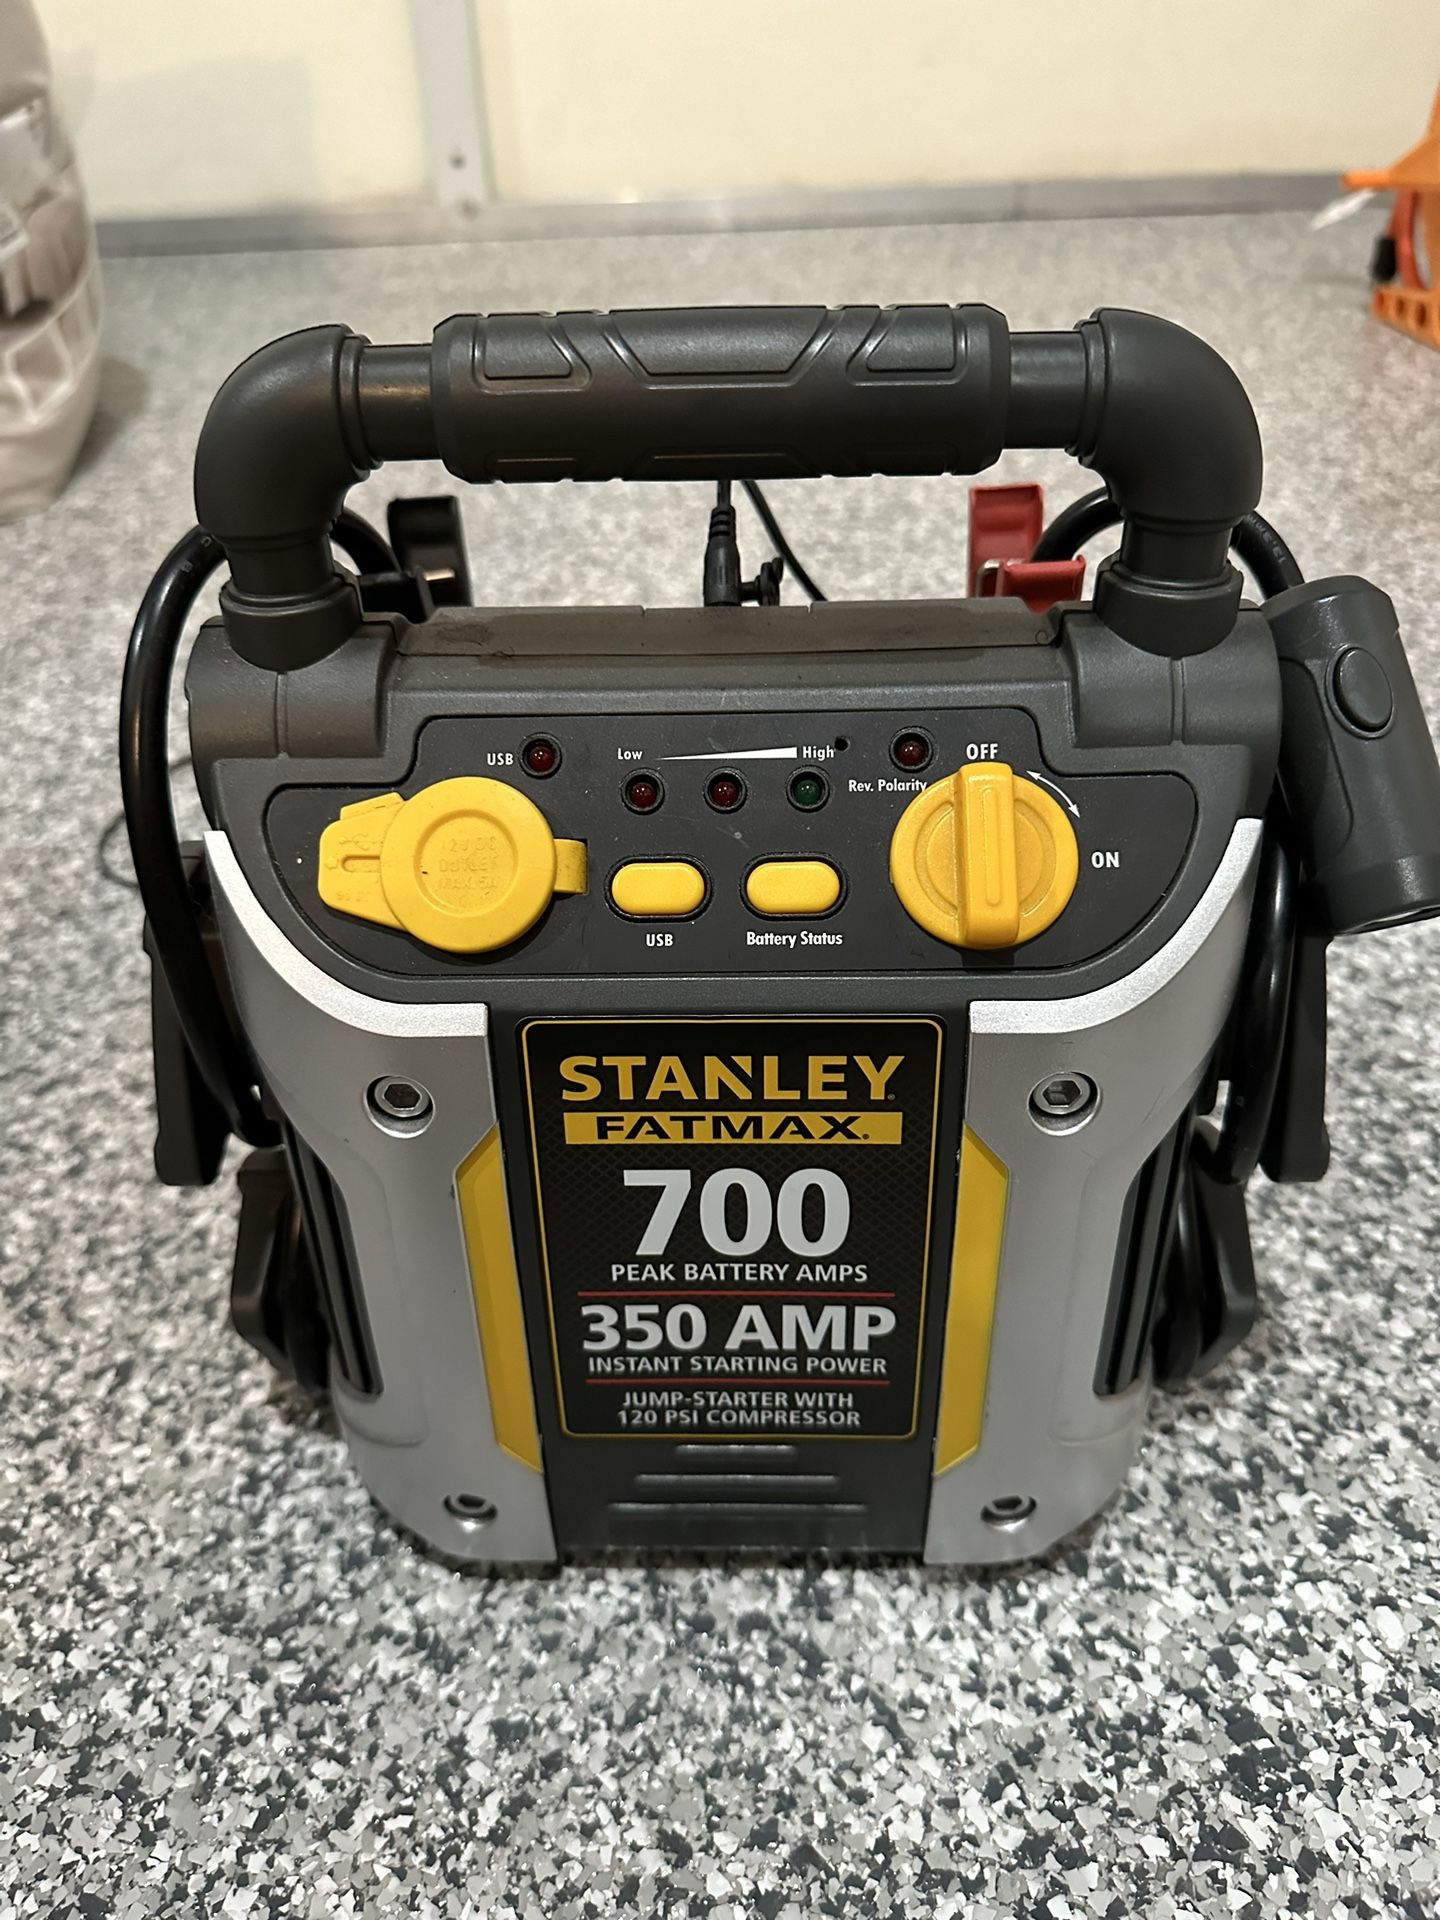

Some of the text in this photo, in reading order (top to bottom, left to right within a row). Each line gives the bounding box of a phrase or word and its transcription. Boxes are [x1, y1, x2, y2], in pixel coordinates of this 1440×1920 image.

[486, 752, 514, 766] USB
[617, 747, 643, 761] Low
[802, 745, 835, 761] High
[966, 743, 999, 760] OFF
[848, 777, 928, 793] Rev. Polarity
[1091, 851, 1120, 868] ON
[646, 933, 674, 947] USB
[746, 930, 843, 949] Battery Status
[559, 1055, 904, 1101] STANLEY
[596, 1115, 862, 1140] FATMAX
[623, 1168, 850, 1257] 700
[611, 1263, 868, 1282] PEAK BATTERY AMPS
[581, 1304, 896, 1351] 350 AMP
[589, 1356, 886, 1373] INSTANT STARTING POWER
[623, 1391, 853, 1407] JUMP-STARTER WITH
[619, 1410, 860, 1426] 120 PSI COMPRESSOR
